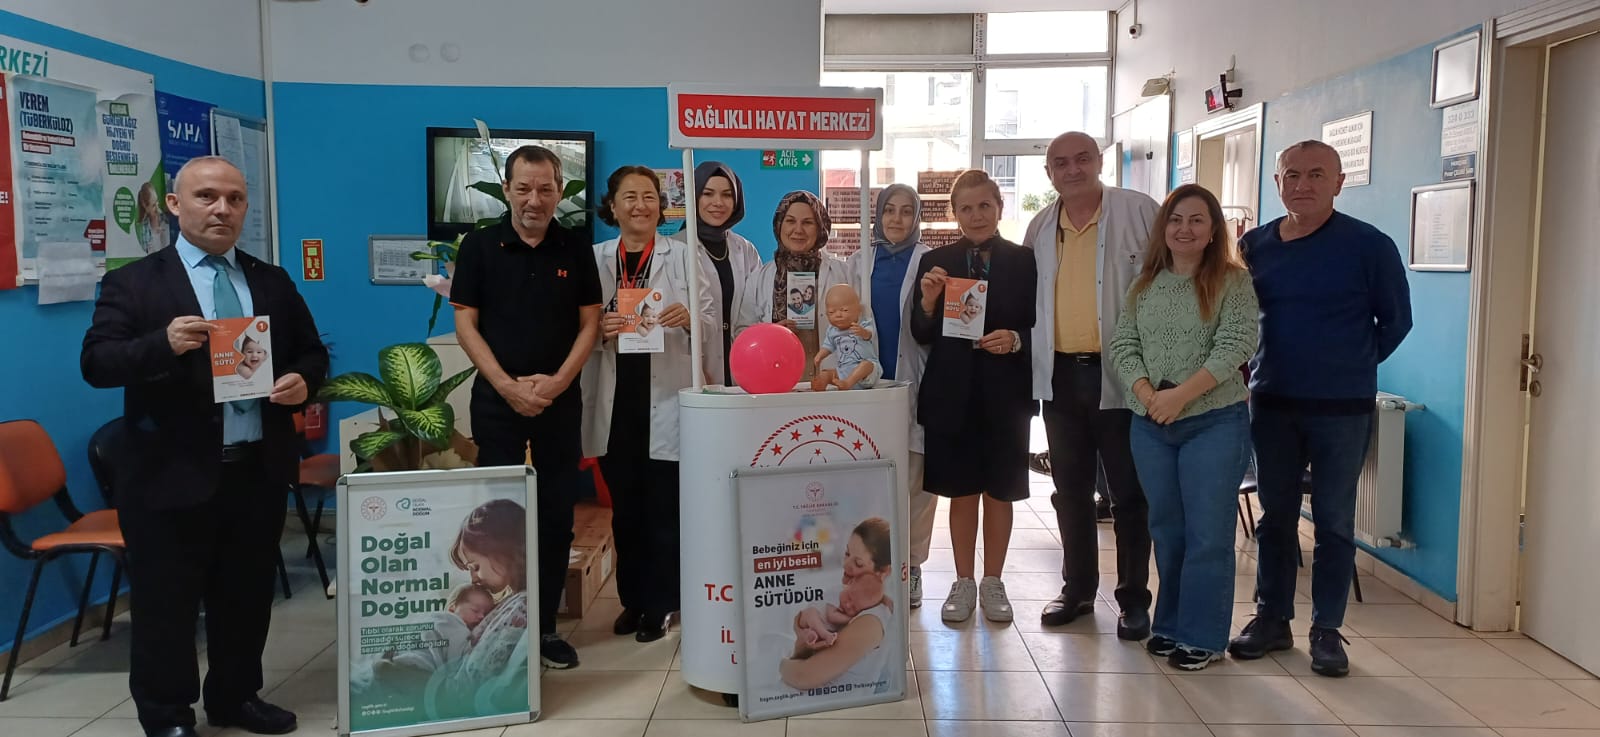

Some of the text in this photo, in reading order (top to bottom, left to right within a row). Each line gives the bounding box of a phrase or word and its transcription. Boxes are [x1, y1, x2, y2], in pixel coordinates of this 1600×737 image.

[19, 91, 49, 112] VEREM
[684, 104, 870, 132] SAĞLIKLI HAYAT MERKEZİ
[361, 531, 430, 555] Doğal
[752, 540, 819, 555] Bebeğiniz için
[361, 555, 418, 574] Olan
[758, 555, 818, 570] en iyi besin
[361, 572, 450, 596] Normal
[754, 573, 795, 590] ANNE
[361, 596, 448, 619] Doğum
[754, 586, 824, 608] SÜTÜDÜR
